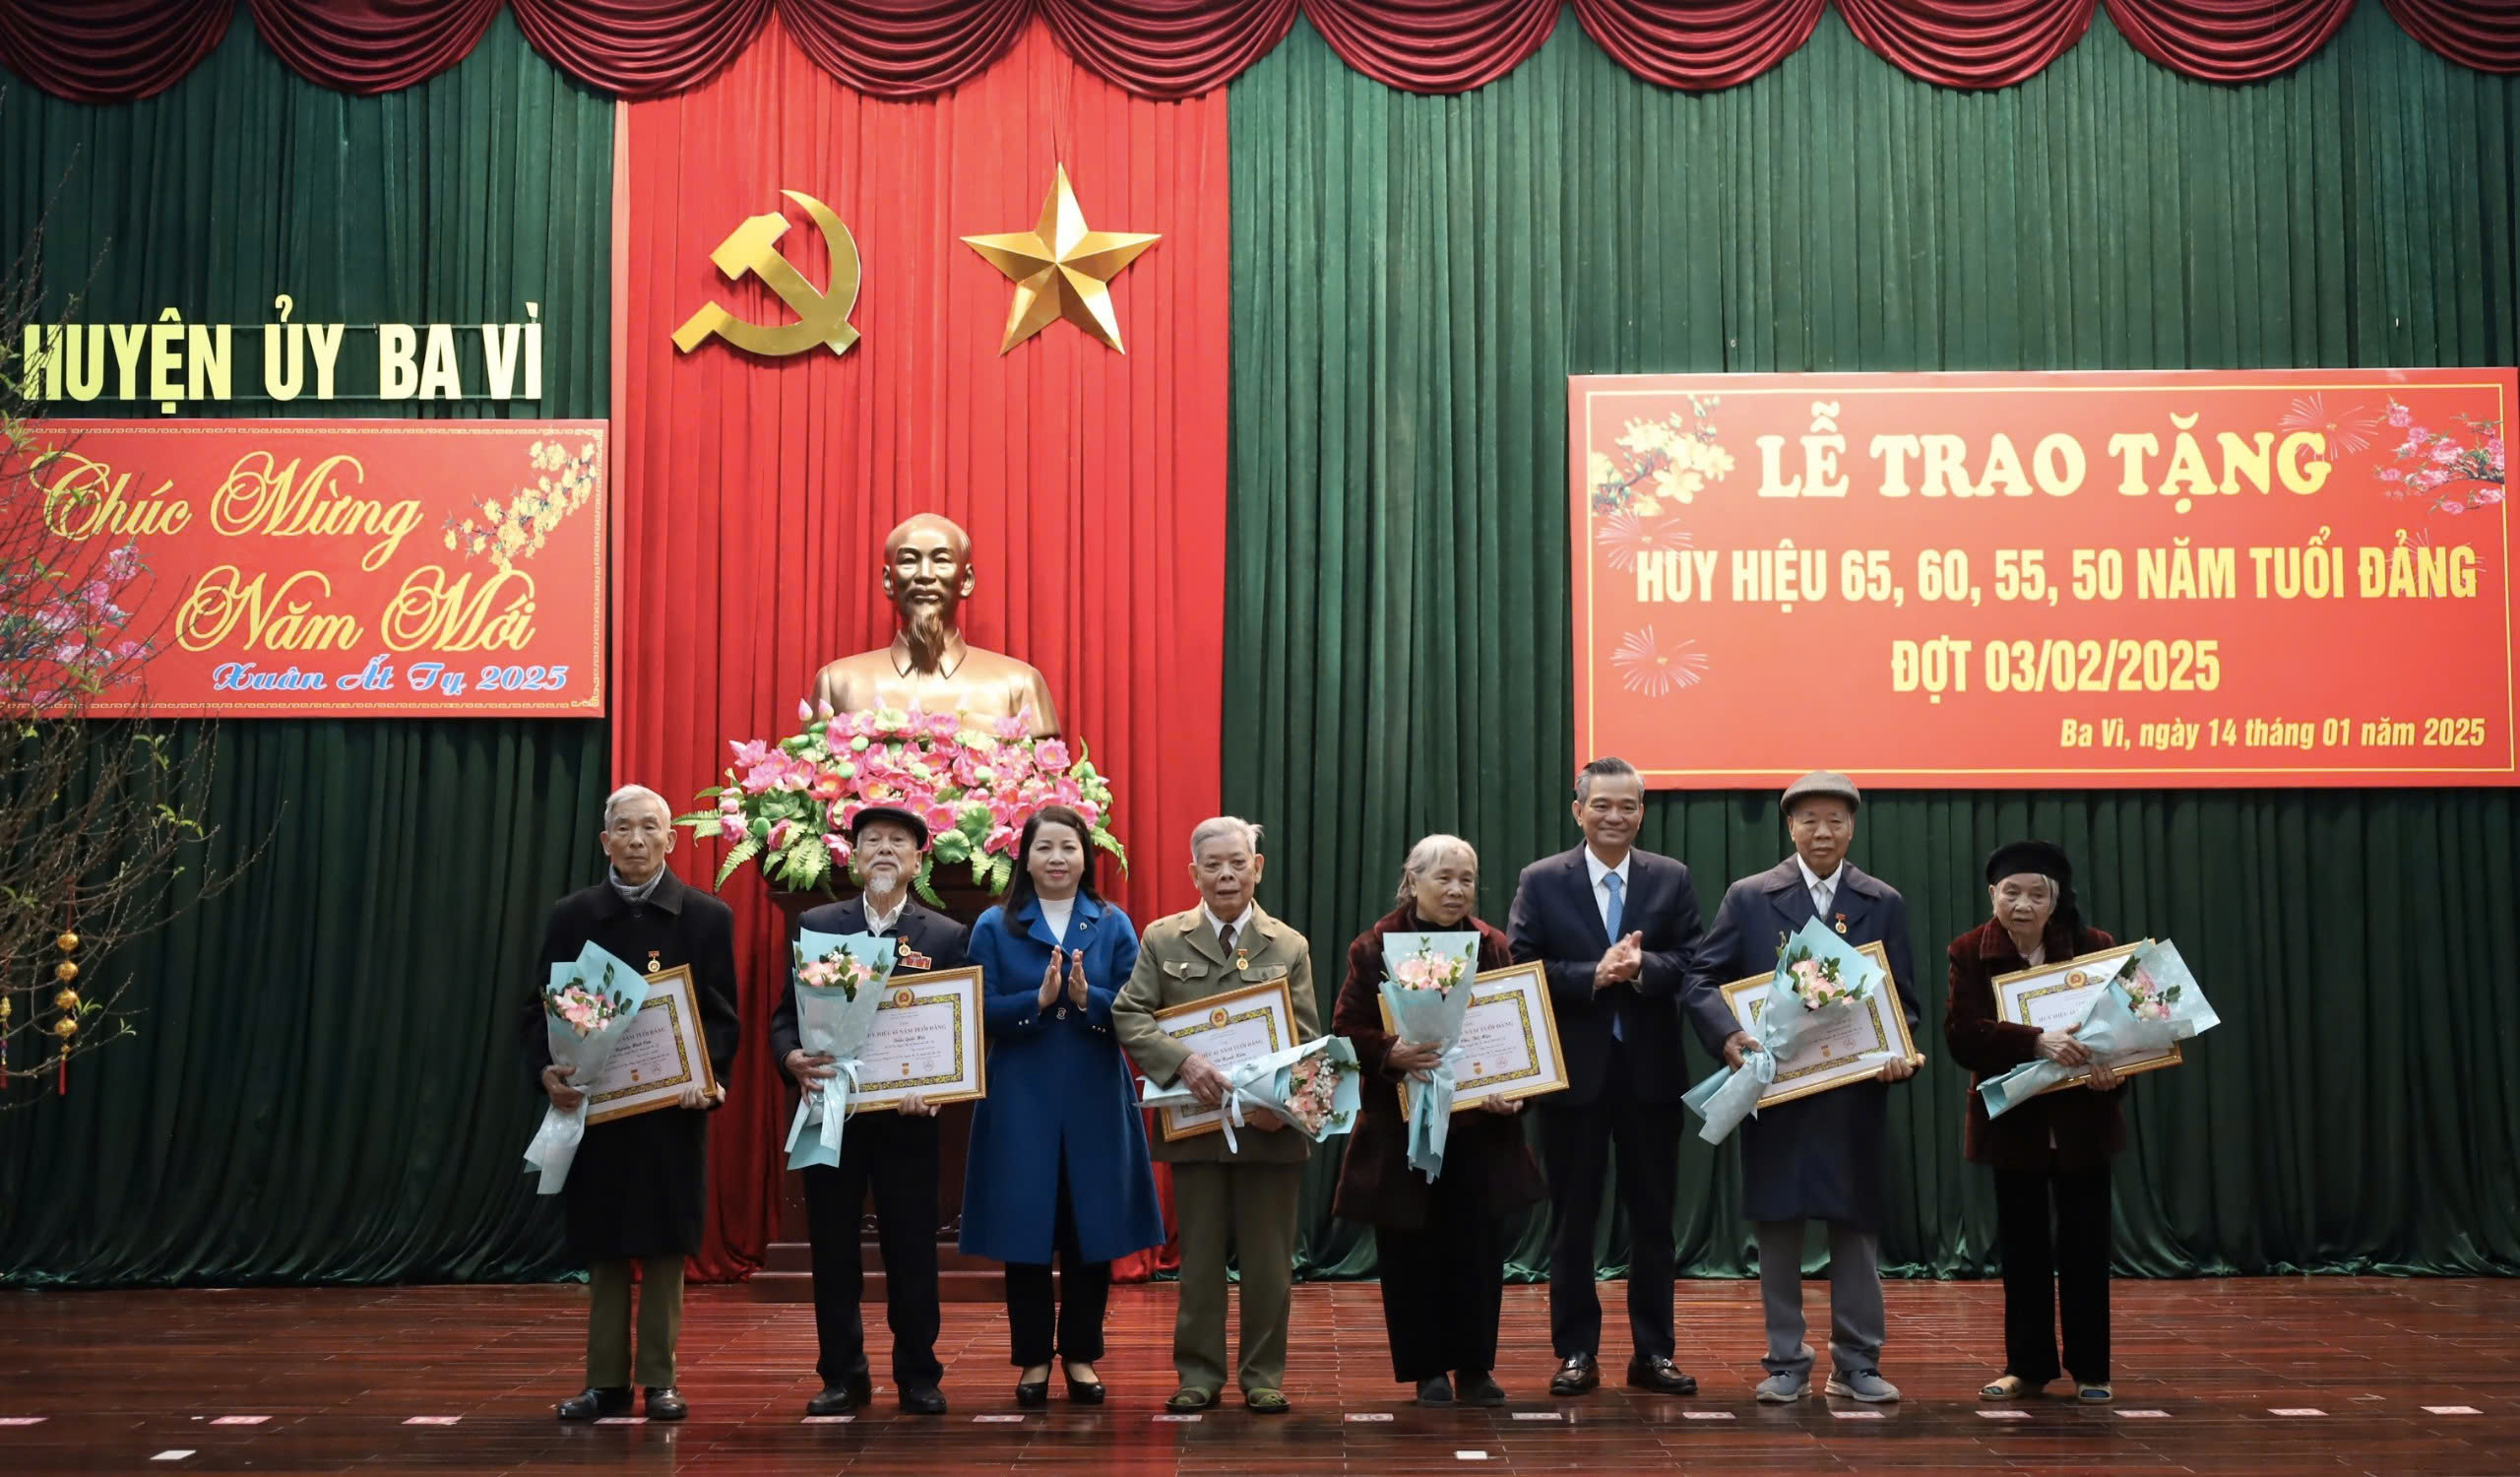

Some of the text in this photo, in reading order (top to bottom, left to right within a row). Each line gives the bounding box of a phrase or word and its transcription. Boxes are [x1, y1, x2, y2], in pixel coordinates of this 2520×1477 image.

[24, 294, 542, 414] HUYỆN ỦY BA VÌ
[1756, 401, 2333, 514] LỄ TRAO TẶNG
[30, 450, 423, 571] Chúc Mừng
[175, 564, 536, 652] Năm Mới
[1636, 526, 2477, 613] HUY HIỆU 65, 60, 55, 50 NĂM TUỔI ĐẢNG
[212, 662, 327, 690] Xuân
[337, 653, 395, 690] Ất
[475, 665, 570, 691] 2025
[1891, 634, 2221, 704] ĐỢT 03/02/2025
[2060, 716, 2486, 751] Ba Vì, ngày 14 tháng 01 năm 2025
